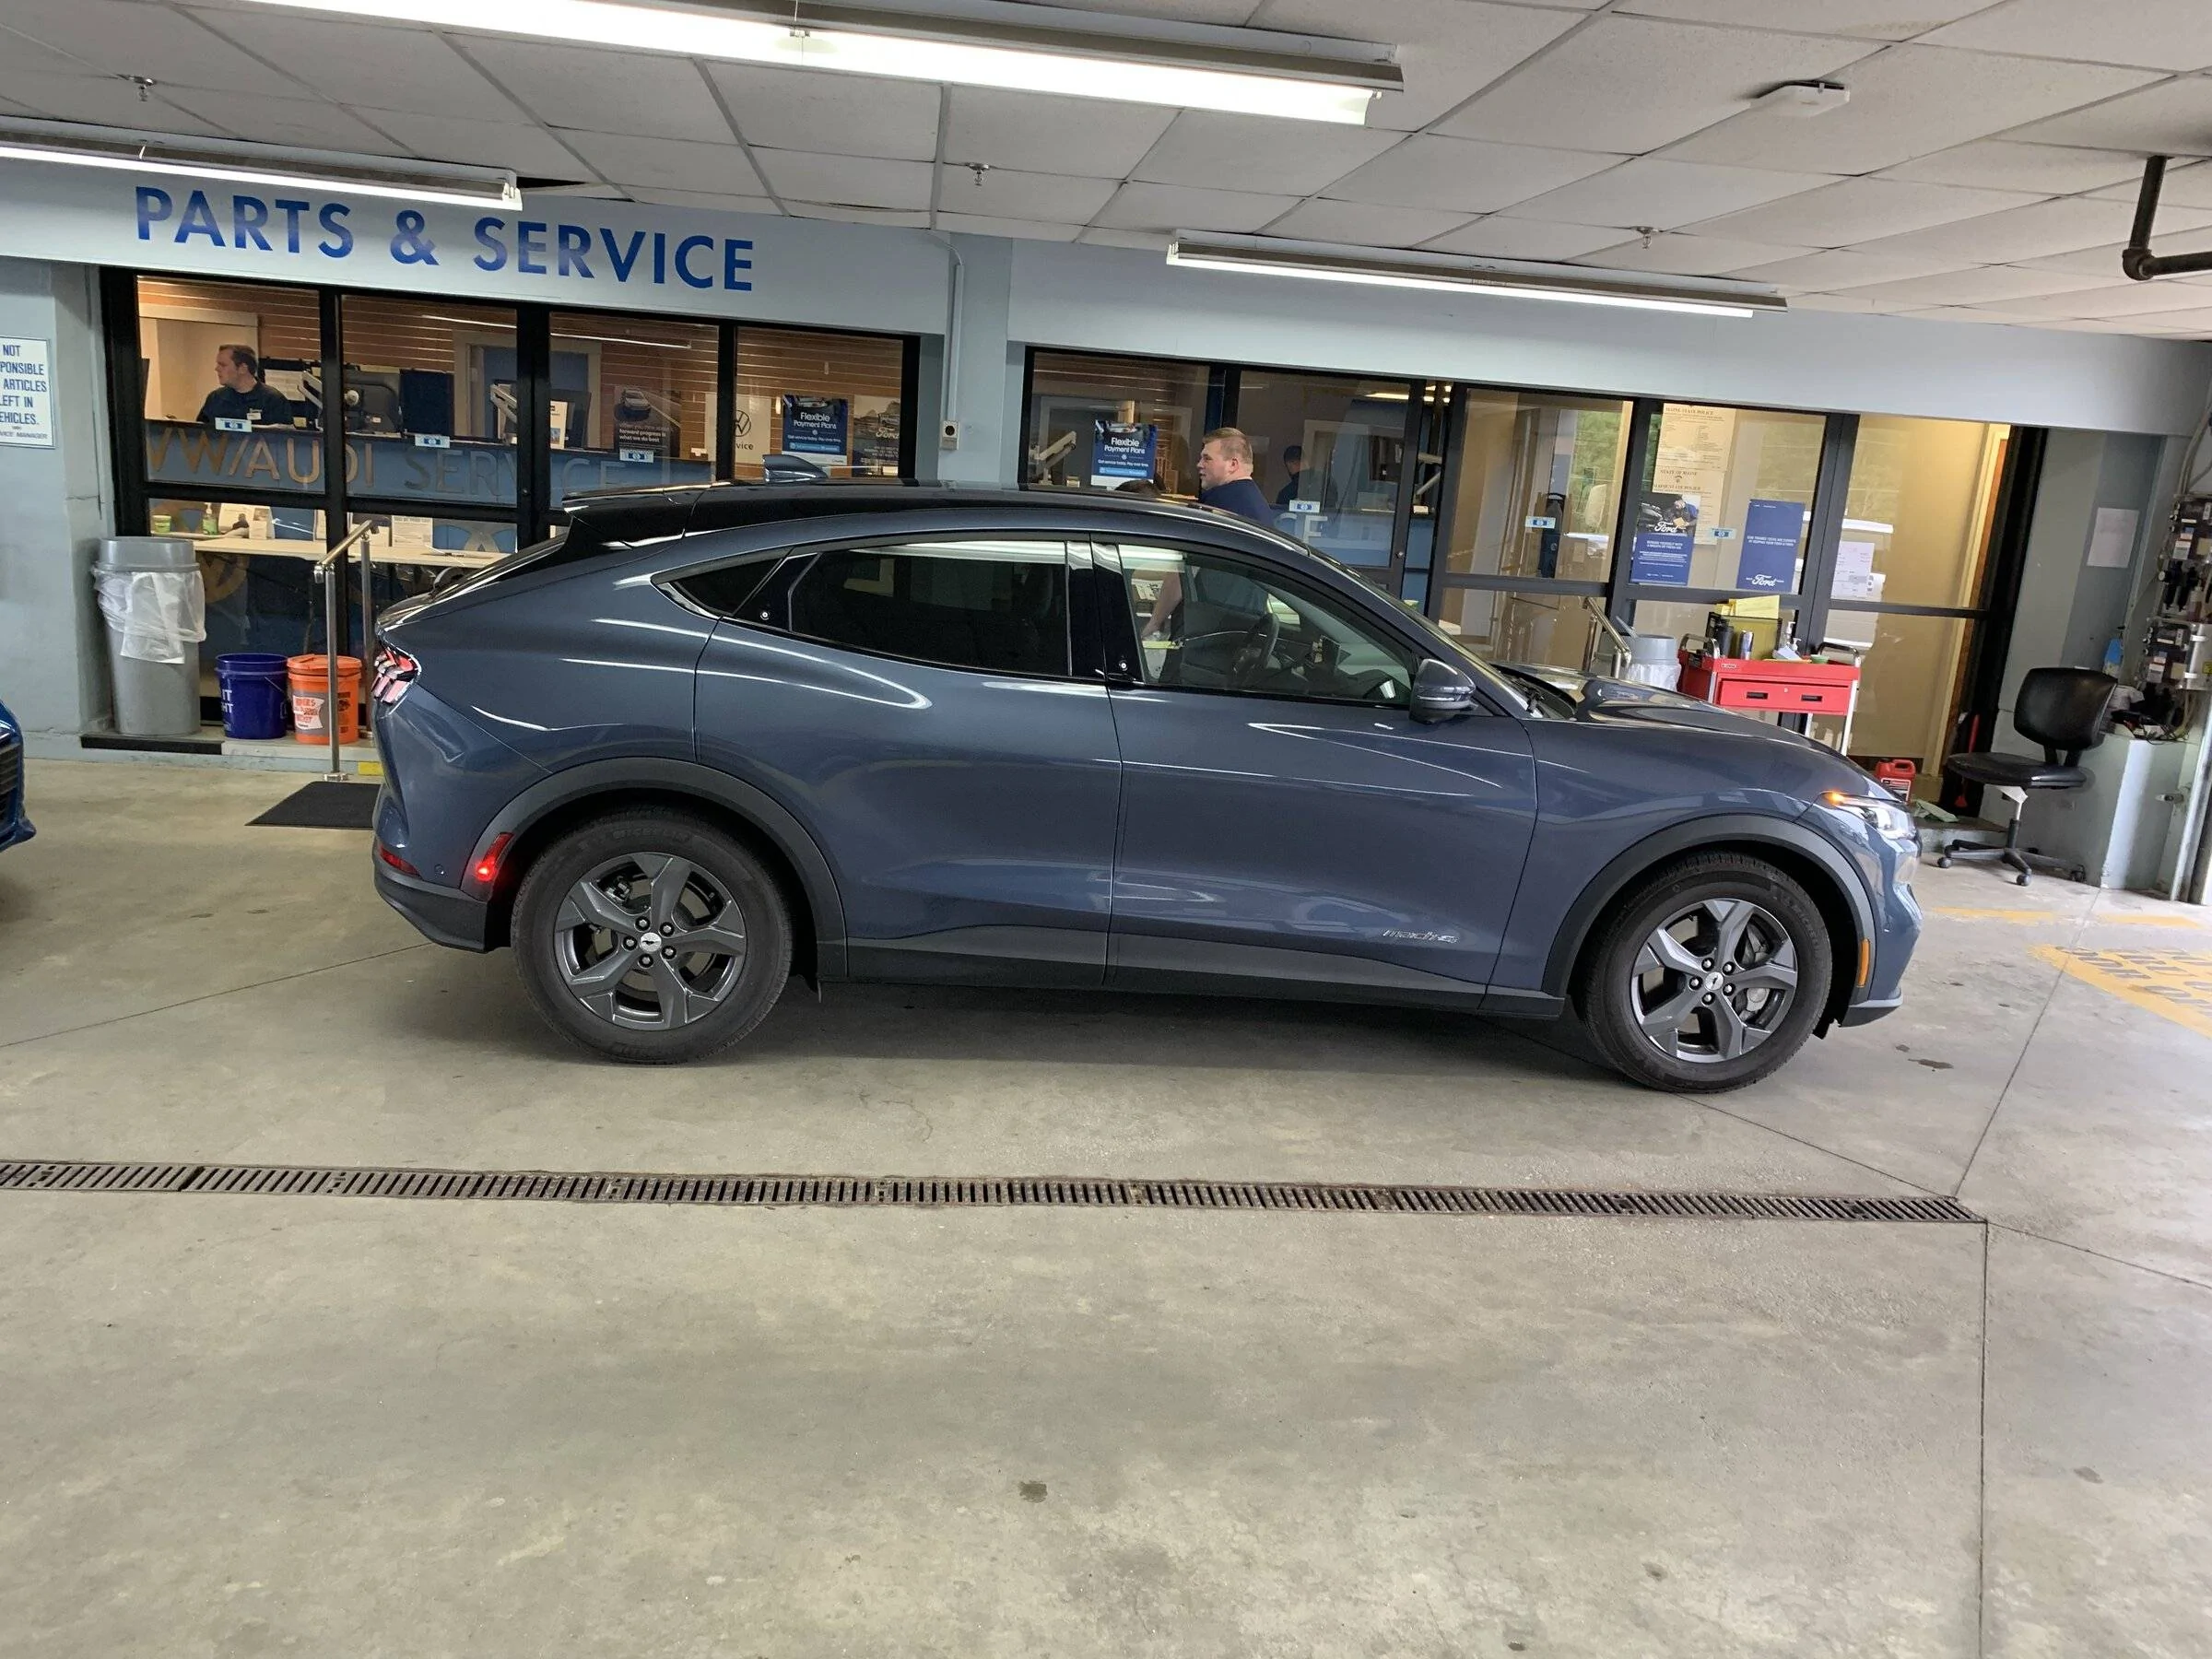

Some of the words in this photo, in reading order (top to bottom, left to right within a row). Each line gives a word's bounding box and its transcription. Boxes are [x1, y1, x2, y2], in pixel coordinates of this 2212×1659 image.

[135, 185, 354, 258] PARTS
[390, 209, 440, 266] &
[474, 217, 753, 291] SERVICE
[3, 345, 20, 357] NOT
[4, 378, 47, 392] ARTICLES
[24, 396, 33, 407] IN
[800, 412, 830, 422] Flexible
[794, 419, 820, 429] Payment
[1111, 437, 1139, 447] Flexible
[1104, 444, 1130, 453] Payment
[1654, 521, 1678, 533] Ford
[1751, 574, 1777, 586] Ford
